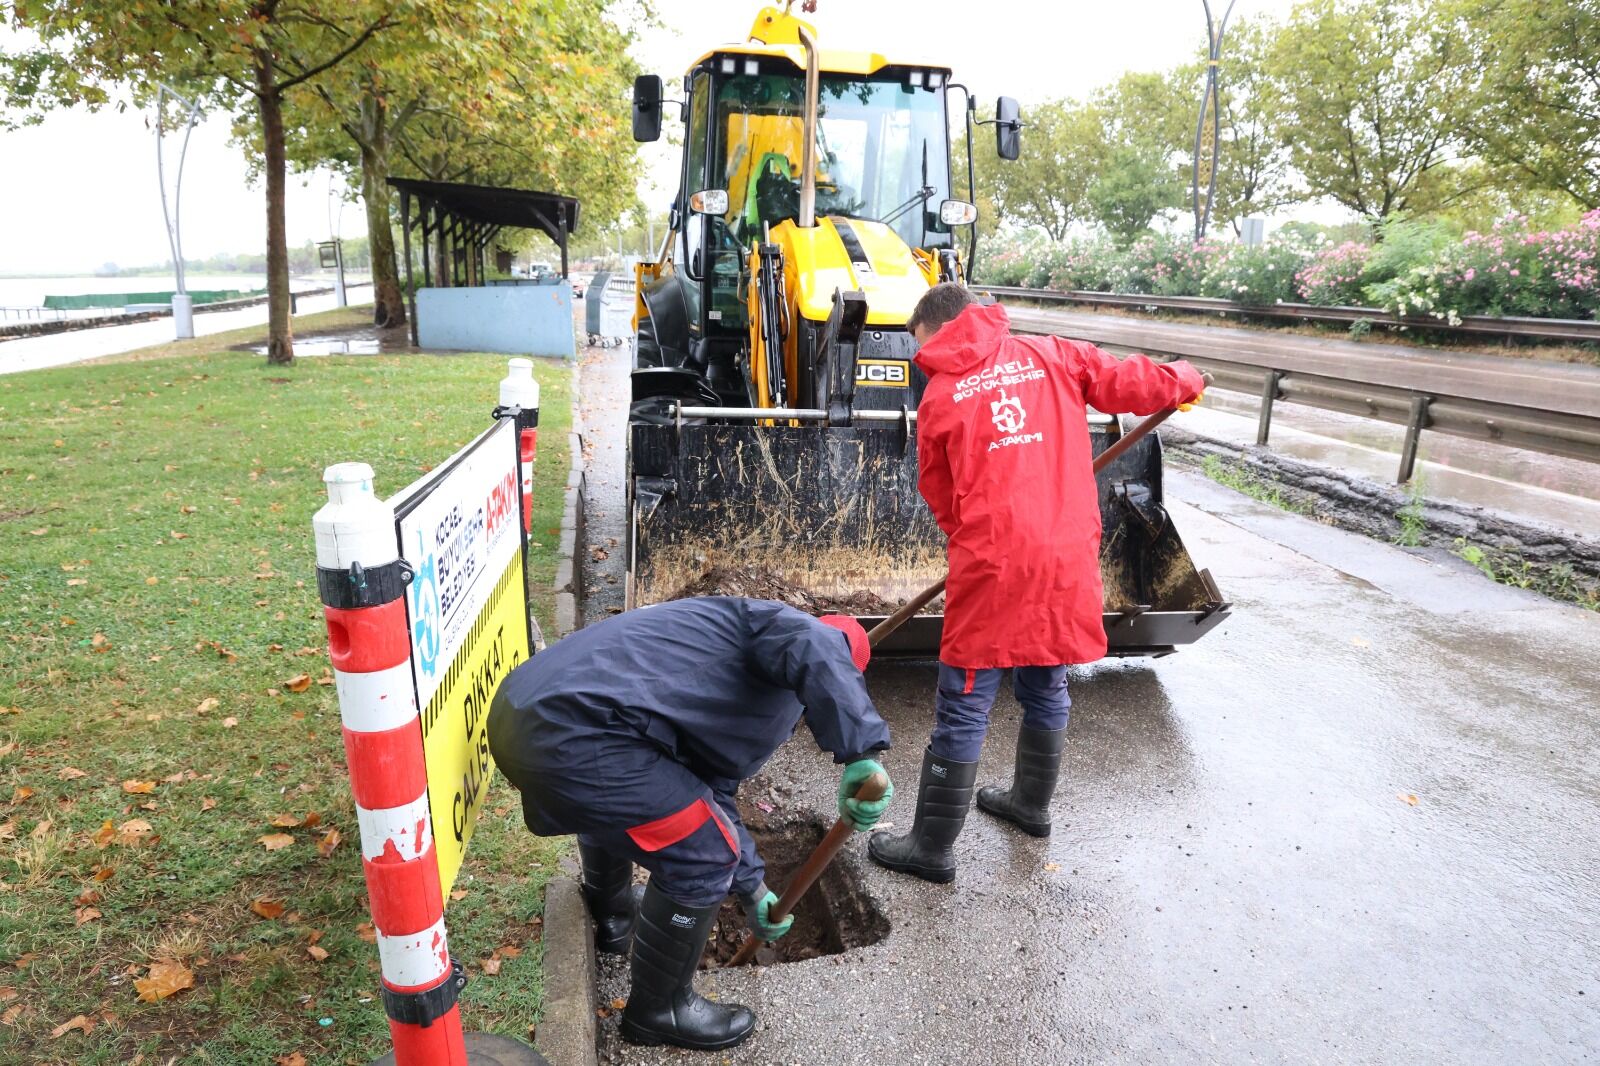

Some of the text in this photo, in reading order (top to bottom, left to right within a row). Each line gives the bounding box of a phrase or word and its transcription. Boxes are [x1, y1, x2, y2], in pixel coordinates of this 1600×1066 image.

[856, 365, 904, 381] JCB
[955, 357, 1035, 391] KOCAELİ
[464, 624, 504, 742] DİKKAT
[453, 728, 490, 853] ÇALIŞ
